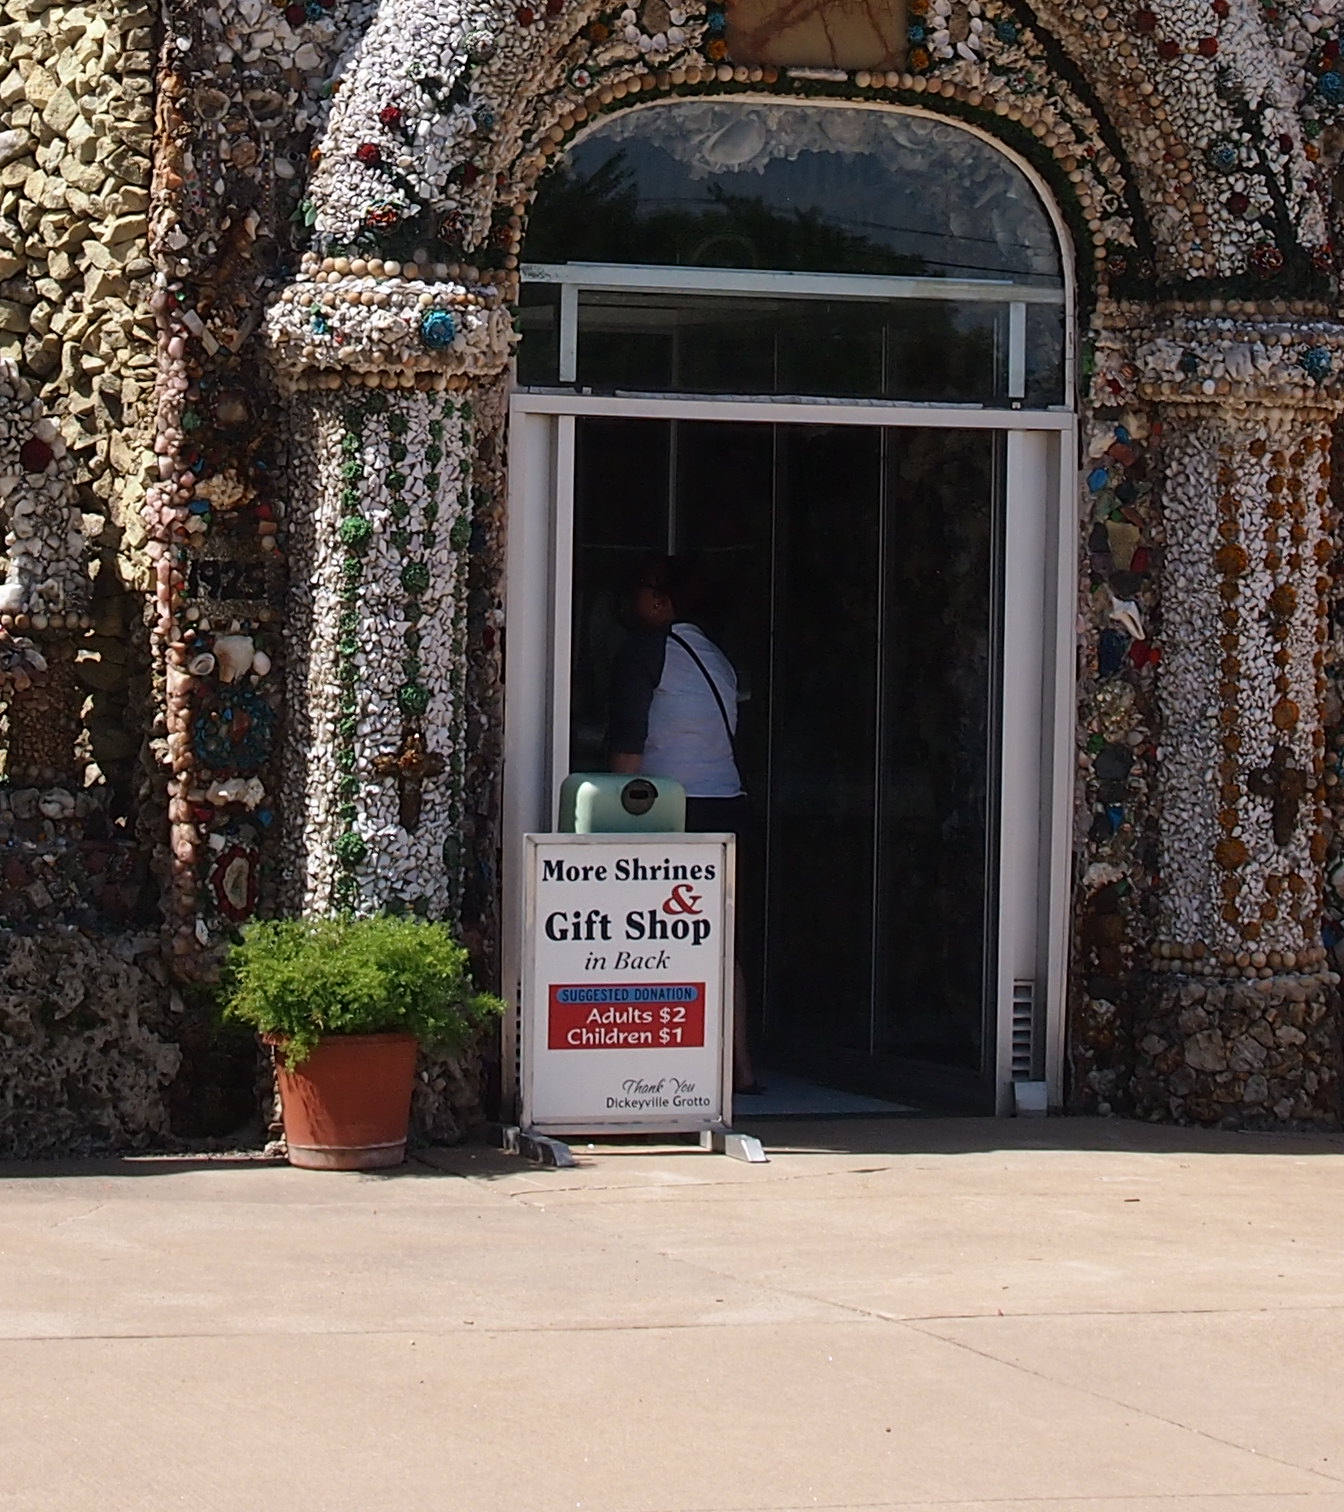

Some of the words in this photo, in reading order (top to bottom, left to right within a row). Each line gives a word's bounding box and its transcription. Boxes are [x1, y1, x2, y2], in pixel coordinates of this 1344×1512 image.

[542, 859, 608, 882] More
[614, 857, 716, 882] Shrines
[662, 883, 703, 915] &
[544, 909, 612, 941] Gift
[625, 908, 711, 946] Shop
[584, 951, 606, 971] in
[613, 949, 671, 971] Back
[562, 988, 629, 1002] SUGGESTED
[634, 987, 692, 1001] DONATION
[586, 1006, 653, 1024] Adults
[659, 1006, 687, 1024] $2
[567, 1027, 652, 1045] Children
[659, 1026, 683, 1045] $1
[622, 1078, 666, 1095] Thank
[669, 1077, 696, 1095] You
[606, 1096, 670, 1111] Dickeyville
[672, 1095, 711, 1108] Grotto
